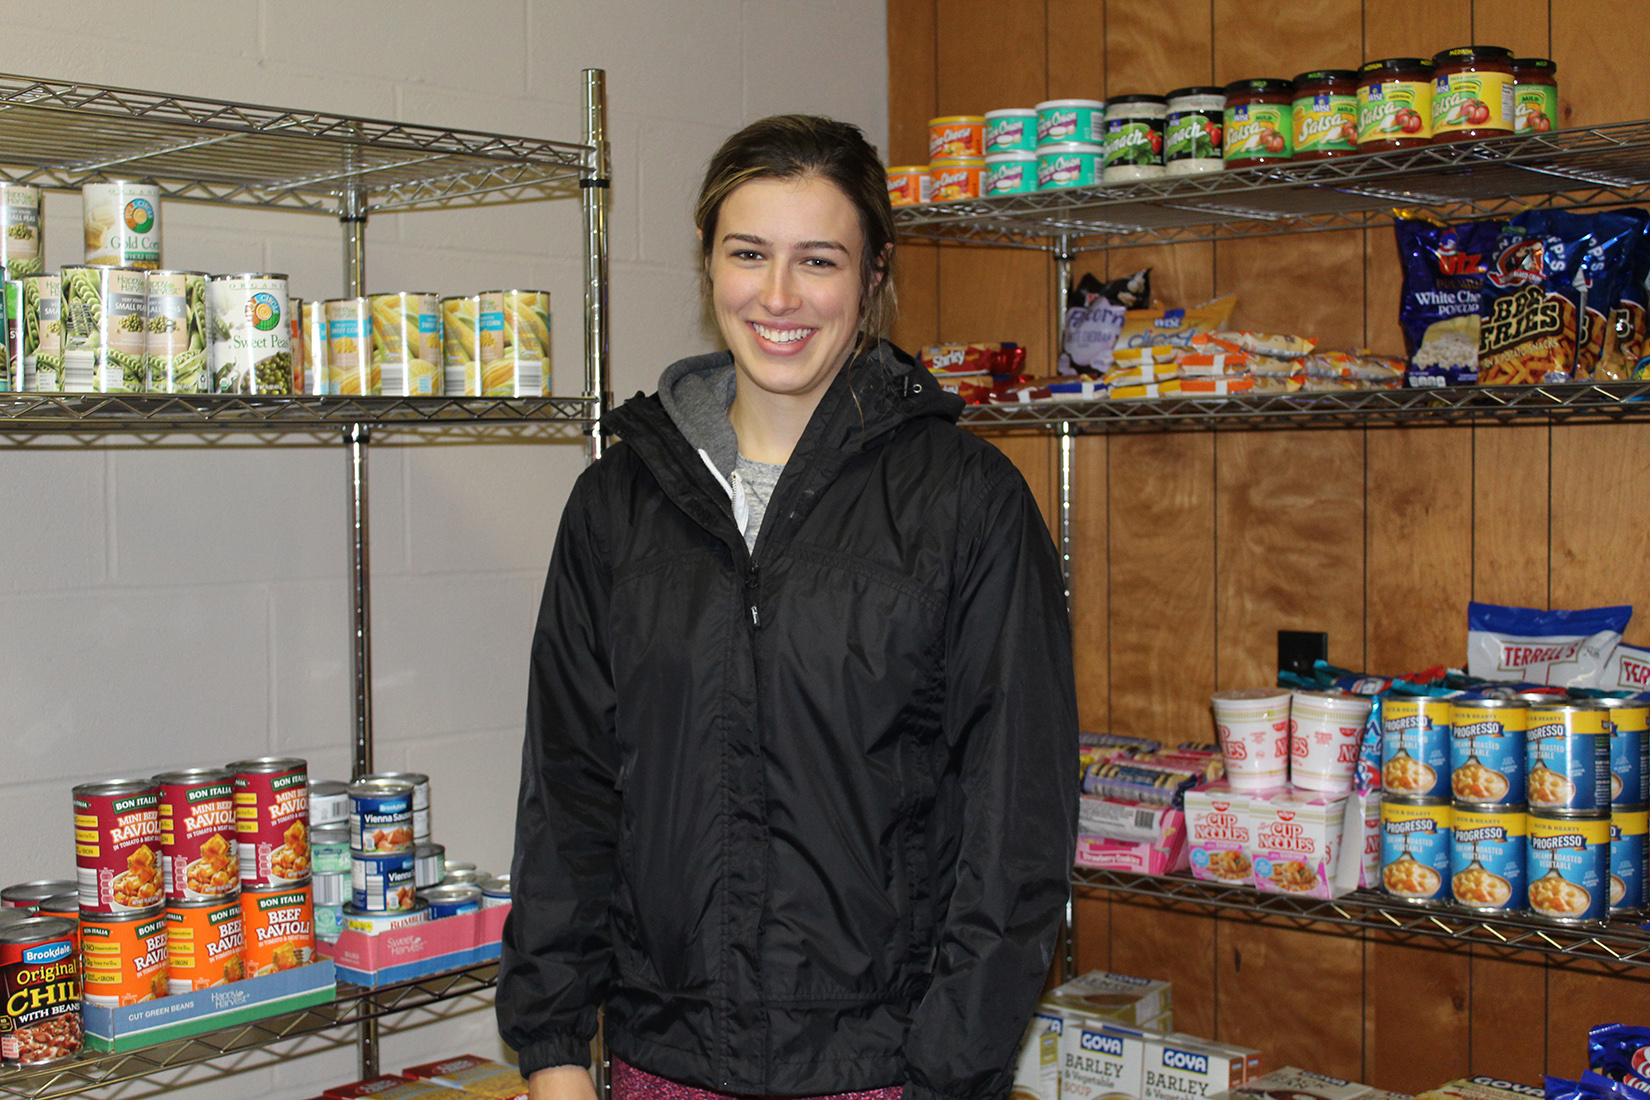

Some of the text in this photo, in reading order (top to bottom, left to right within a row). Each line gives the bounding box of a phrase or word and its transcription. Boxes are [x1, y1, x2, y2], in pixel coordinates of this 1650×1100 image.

[1359, 101, 1402, 133] Salsa
[944, 127, 971, 143] Cheese
[1299, 113, 1348, 142] Salsa
[1224, 122, 1267, 152] Salsa
[120, 284, 146, 292] Harve
[1415, 290, 1457, 305] White
[1494, 284, 1544, 324] BBQ
[44, 308, 60, 316] SMA
[114, 302, 136, 311] SMALL
[1480, 301, 1559, 352] FRIES
[233, 334, 290, 349] Sweet Peas
[1528, 336, 1560, 353] SNACKS
[933, 349, 966, 370] Shirley
[1503, 642, 1580, 667] TERRELL'S
[1384, 715, 1428, 732] PROGRESSO
[1453, 721, 1499, 739] PROGRESSO
[273, 778, 291, 789] BON
[188, 786, 232, 801] BON ITALIA
[275, 790, 297, 804] MINI
[115, 800, 136, 812] BON
[190, 800, 233, 817] MINI BEEF
[268, 797, 308, 820] RAVIO
[118, 812, 143, 827] MINI
[364, 814, 393, 824] Vienna
[1206, 812, 1238, 828] CUP
[1386, 819, 1433, 834] PROGRESSO
[110, 820, 161, 844] RAVIOL
[193, 826, 213, 838] TOMATO
[1194, 824, 1249, 843] NOODLES
[1270, 821, 1303, 838] CUP
[1455, 827, 1503, 842] PROGRESSO
[119, 838, 140, 849] TOMATO
[1258, 833, 1315, 854] NOODLES
[1532, 835, 1582, 850] PROGRESSO
[1540, 860, 1572, 871] VEGETABLE
[1554, 853, 1583, 864] ROASTED
[260, 895, 305, 909] BON ITALIA
[211, 912, 229, 923] BON
[267, 907, 302, 925] BEEF
[138, 923, 156, 936] BON
[255, 921, 310, 941] RAVIOLI
[86, 943, 95, 952] NO
[206, 933, 243, 957] RAVIO
[387, 935, 415, 949] Sweet
[391, 941, 424, 956] Harvest
[26, 944, 71, 961] Brookdale
[133, 946, 169, 972] RAVIO
[16, 959, 77, 986] Original
[128, 1000, 195, 1021] CUT GREEN BEANS
[214, 995, 246, 1009] Harvest
[18, 1002, 81, 1024] WITH BEANS
[1082, 1033, 1122, 1055] GOYA
[1065, 1053, 1124, 1078] BARLEY
[1164, 1050, 1207, 1073] GOYA
[1064, 1069, 1115, 1089] & Vegetable
[1146, 1070, 1209, 1097] BARLEY
[1473, 1076, 1546, 1098] GOYA
[1063, 1081, 1092, 1097] SOUP
[1145, 1086, 1152, 1097] &
